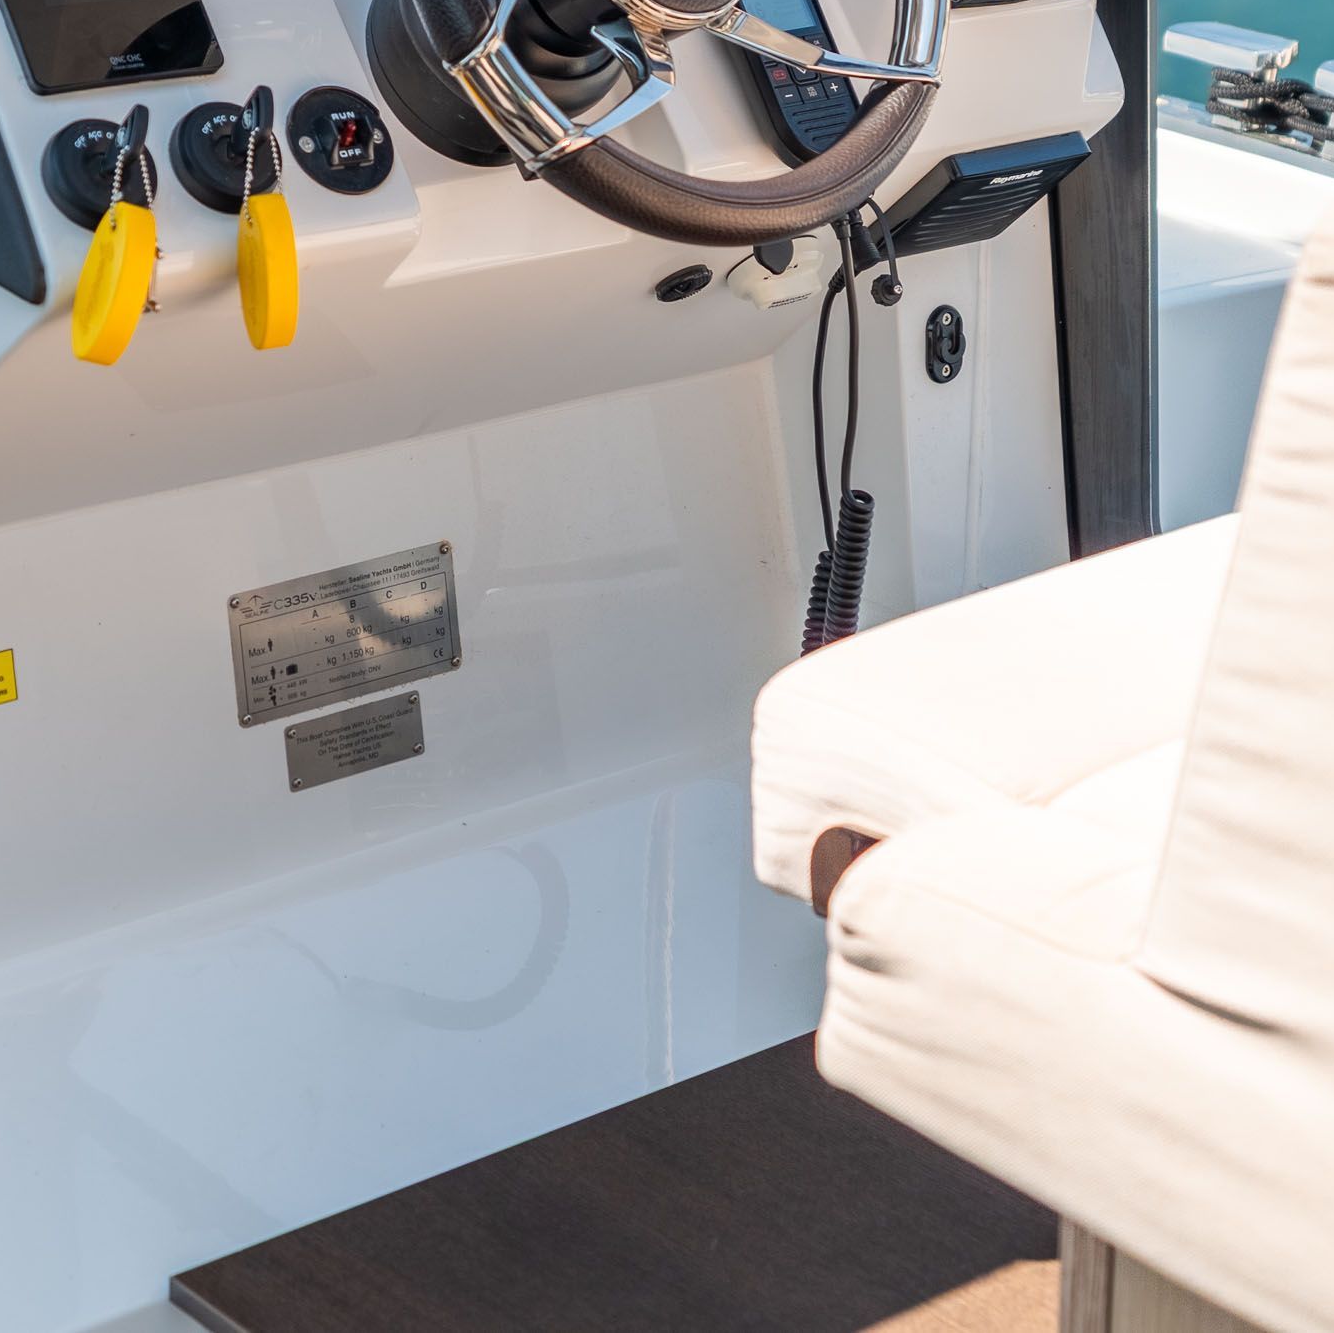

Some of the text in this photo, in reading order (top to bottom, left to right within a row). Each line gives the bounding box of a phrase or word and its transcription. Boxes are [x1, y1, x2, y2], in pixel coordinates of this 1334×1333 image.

[331, 111, 355, 121] RUN
[339, 148, 362, 158] OFF
[989, 169, 1044, 185] Raymarine
[348, 573, 371, 584] Sealine
[371, 568, 392, 578] Yachts
[393, 562, 412, 573] GmbH
[415, 556, 440, 568] Germany
[312, 581, 427, 619] A B C D
[324, 634, 335, 644] kg
[362, 624, 373, 635] kg
[400, 615, 410, 625] kg
[433, 606, 444, 616] kg
[348, 615, 355, 624] 8
[326, 655, 337, 667] kg
[364, 645, 375, 656] kg
[401, 635, 412, 646] kg
[435, 626, 445, 637] kg
[296, 736, 308, 745] This
[309, 732, 323, 742] Boat
[324, 725, 351, 737] Complies
[352, 720, 365, 730] With
[379, 712, 395, 723] Coast
[396, 707, 414, 718] Guard
